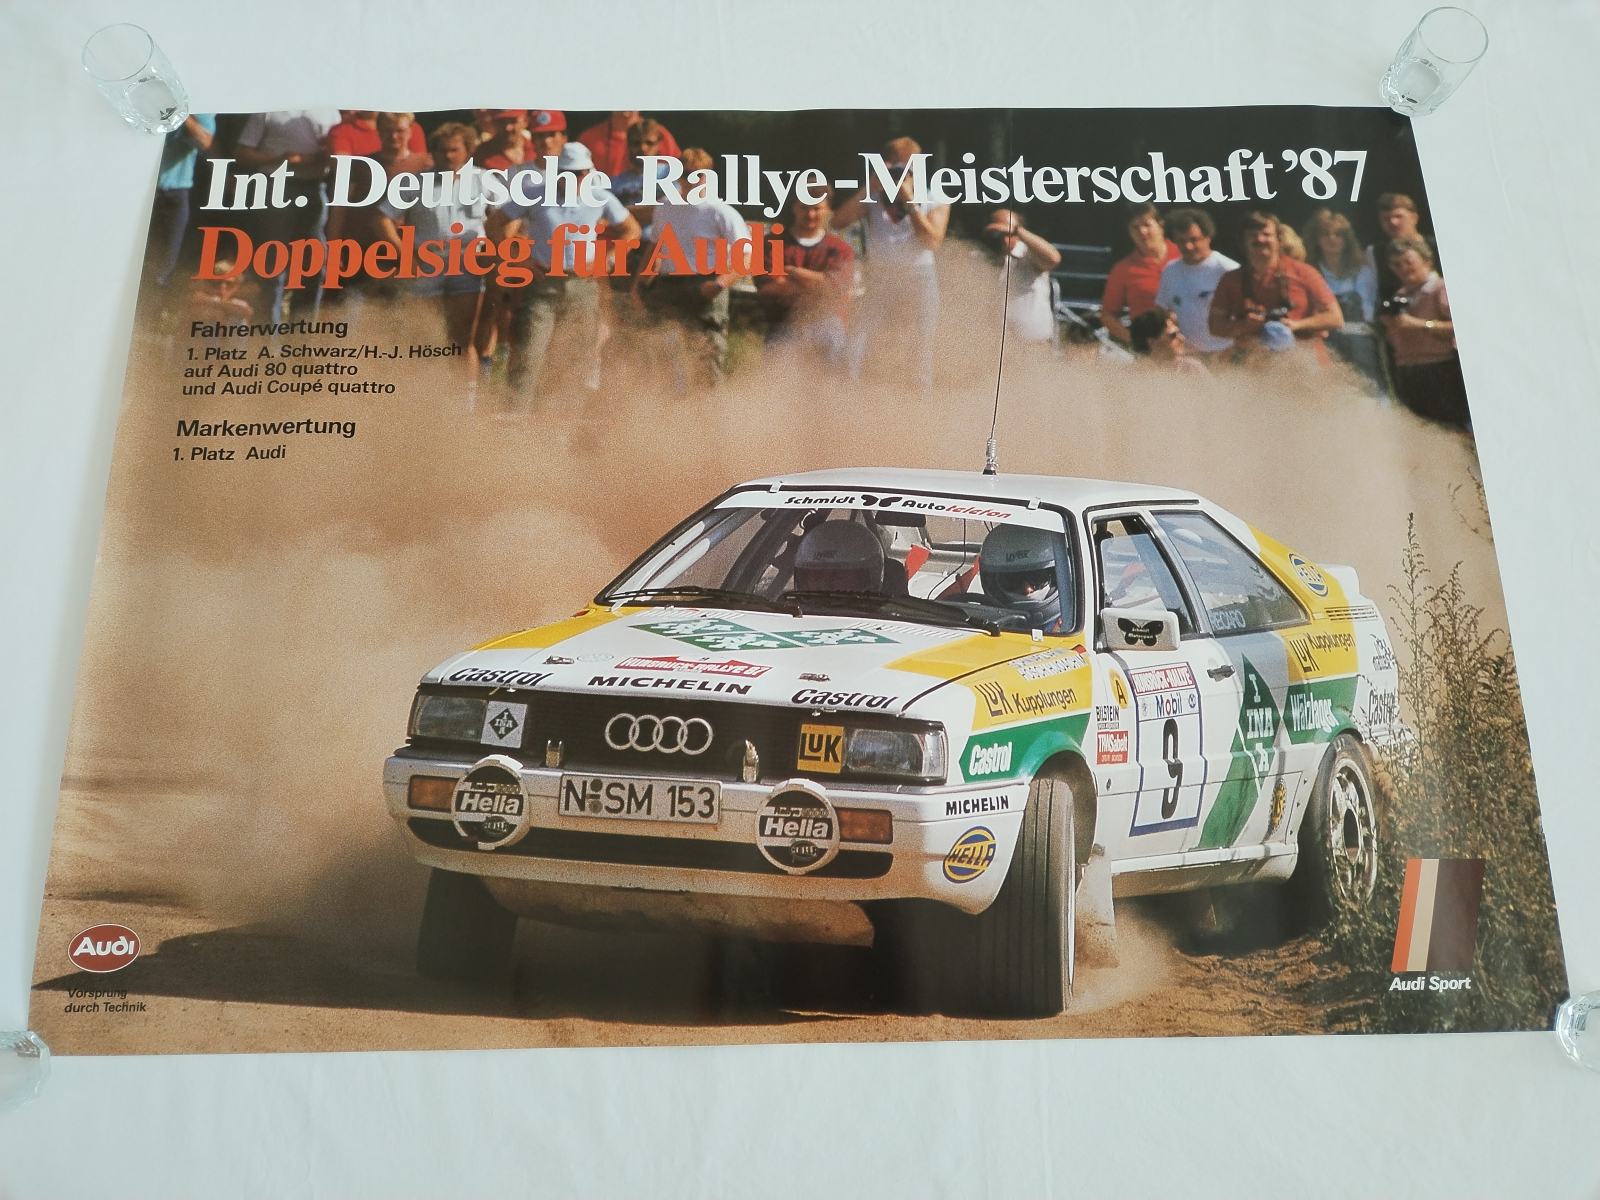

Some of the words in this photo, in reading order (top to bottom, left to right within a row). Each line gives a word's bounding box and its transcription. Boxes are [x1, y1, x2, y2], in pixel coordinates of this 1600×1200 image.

[200, 158, 308, 210] Int.
[325, 154, 612, 210] Deutsche
[191, 221, 536, 290] Doppelsieg
[545, 223, 641, 277] für
[640, 223, 789, 278] Audi
[190, 320, 349, 338] Fahrerwertung
[186, 347, 199, 361] 1.
[204, 347, 248, 361] Platz
[257, 346, 275, 360] A.
[408, 342, 462, 358] Hösch
[184, 364, 213, 378] auf
[217, 364, 259, 378] Audi
[264, 362, 287, 377] 80
[291, 362, 359, 379] quattro
[182, 382, 216, 396] und
[221, 380, 263, 395] Audi
[267, 378, 323, 397] Coupé
[327, 380, 396, 397] quattro
[176, 418, 357, 438] Markenwertung
[172, 447, 185, 461] 1.
[190, 446, 236, 461] Platz
[245, 445, 287, 460] Audi
[784, 495, 856, 505] Schmidt
[1307, 631, 1357, 653] Kupplungen
[449, 668, 554, 687] Castrol
[588, 675, 753, 695] MICHELIN
[791, 688, 900, 709] Castrol
[1012, 688, 1078, 715] Kupplungen
[1115, 680, 1128, 704] A
[1095, 705, 1120, 721] BILSTEIN
[1155, 693, 1183, 717] Mobil
[1246, 707, 1275, 740] INA
[969, 741, 1013, 776] Castrol
[1162, 718, 1184, 820] 9
[460, 792, 520, 814] Hella
[666, 785, 716, 819] 153
[945, 795, 1009, 816] MICHELIN
[764, 817, 829, 838] Hella
[947, 842, 997, 868] HELLA
[73, 935, 135, 956] Audi
[68, 988, 128, 1000] Vorsprung
[1389, 976, 1426, 991] Audi
[1428, 975, 1472, 993] Sport
[64, 1002, 100, 1013] durch
[103, 1001, 147, 1013] Technik
